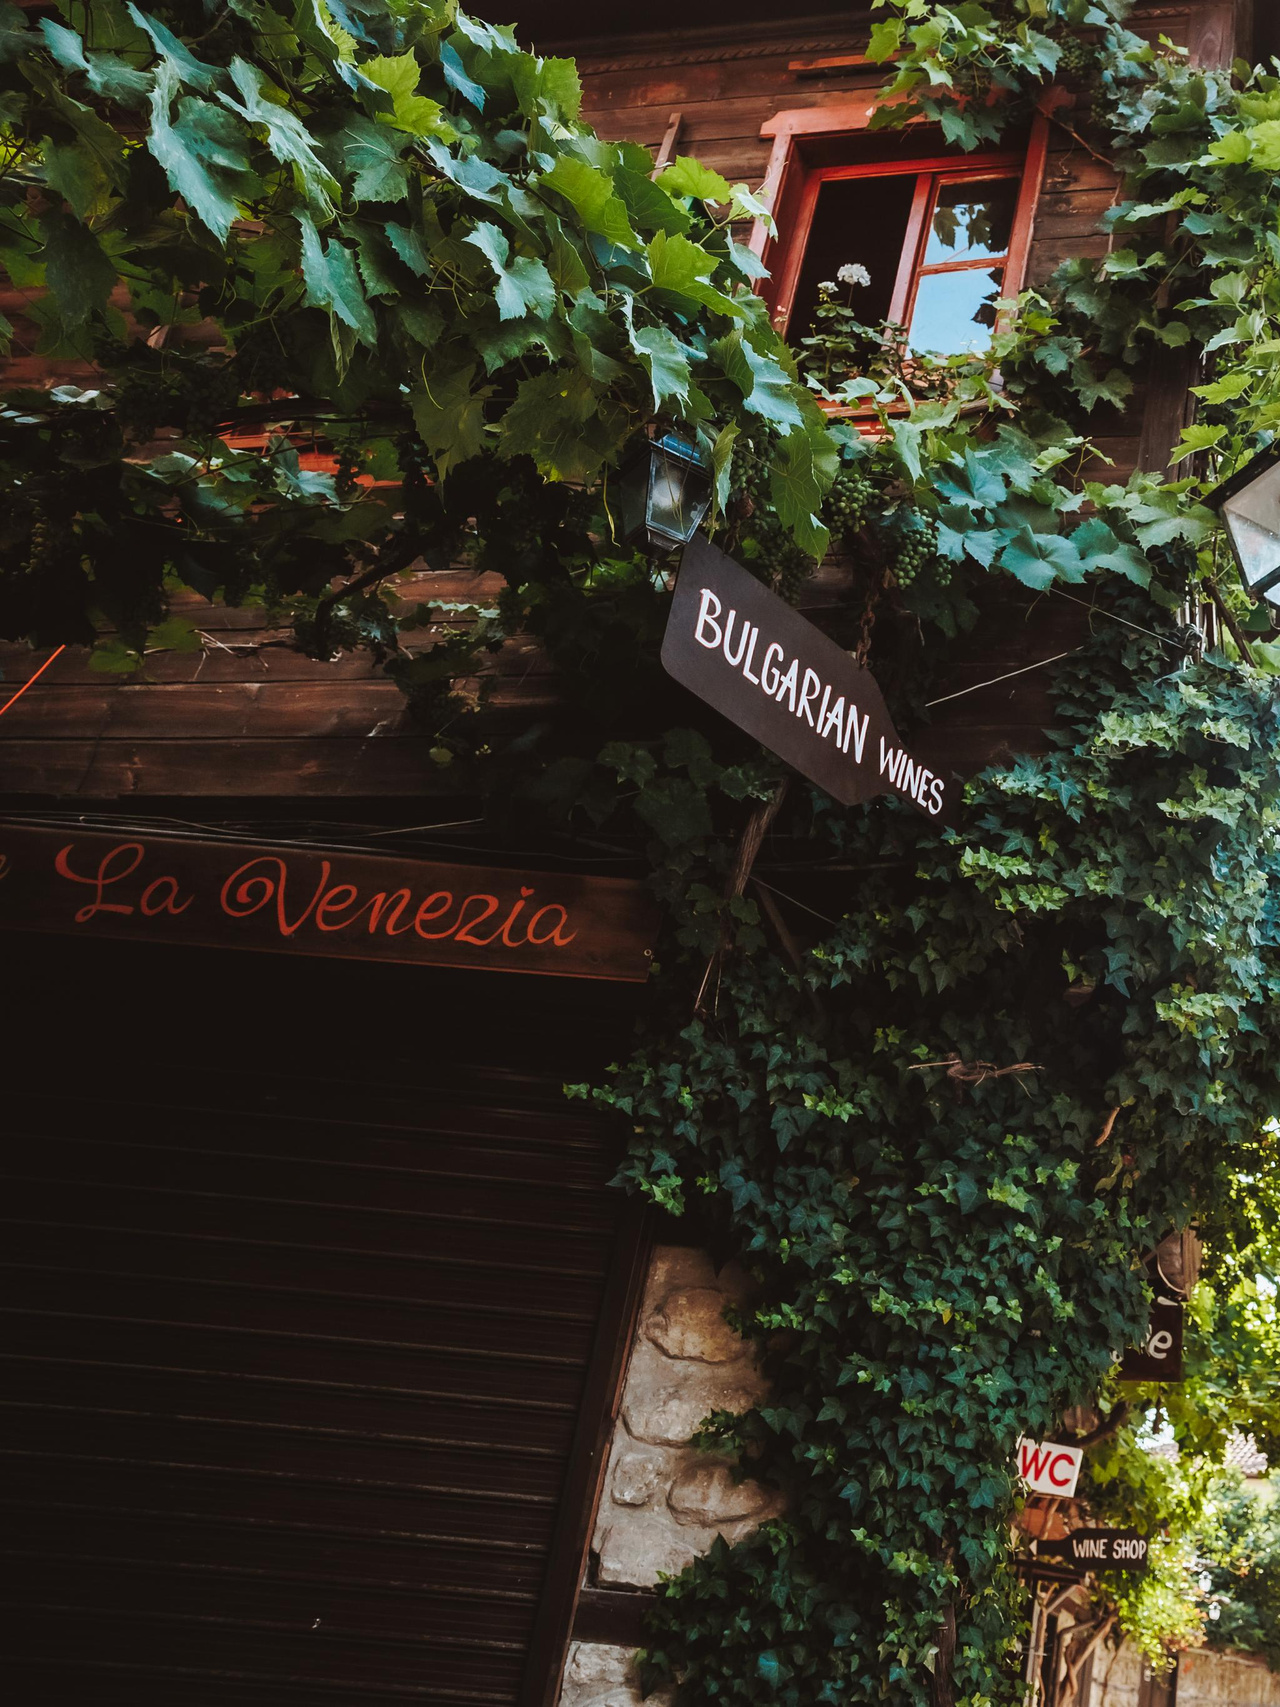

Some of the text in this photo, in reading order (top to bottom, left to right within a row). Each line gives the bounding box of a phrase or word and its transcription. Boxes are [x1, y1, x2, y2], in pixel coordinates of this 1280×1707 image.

[695, 588, 945, 815] BULGARIAN WINES
[55, 843, 577, 948] La Venezia
[1022, 1445, 1075, 1487] WC
[1072, 1539, 1147, 1560] WINE SHOP
